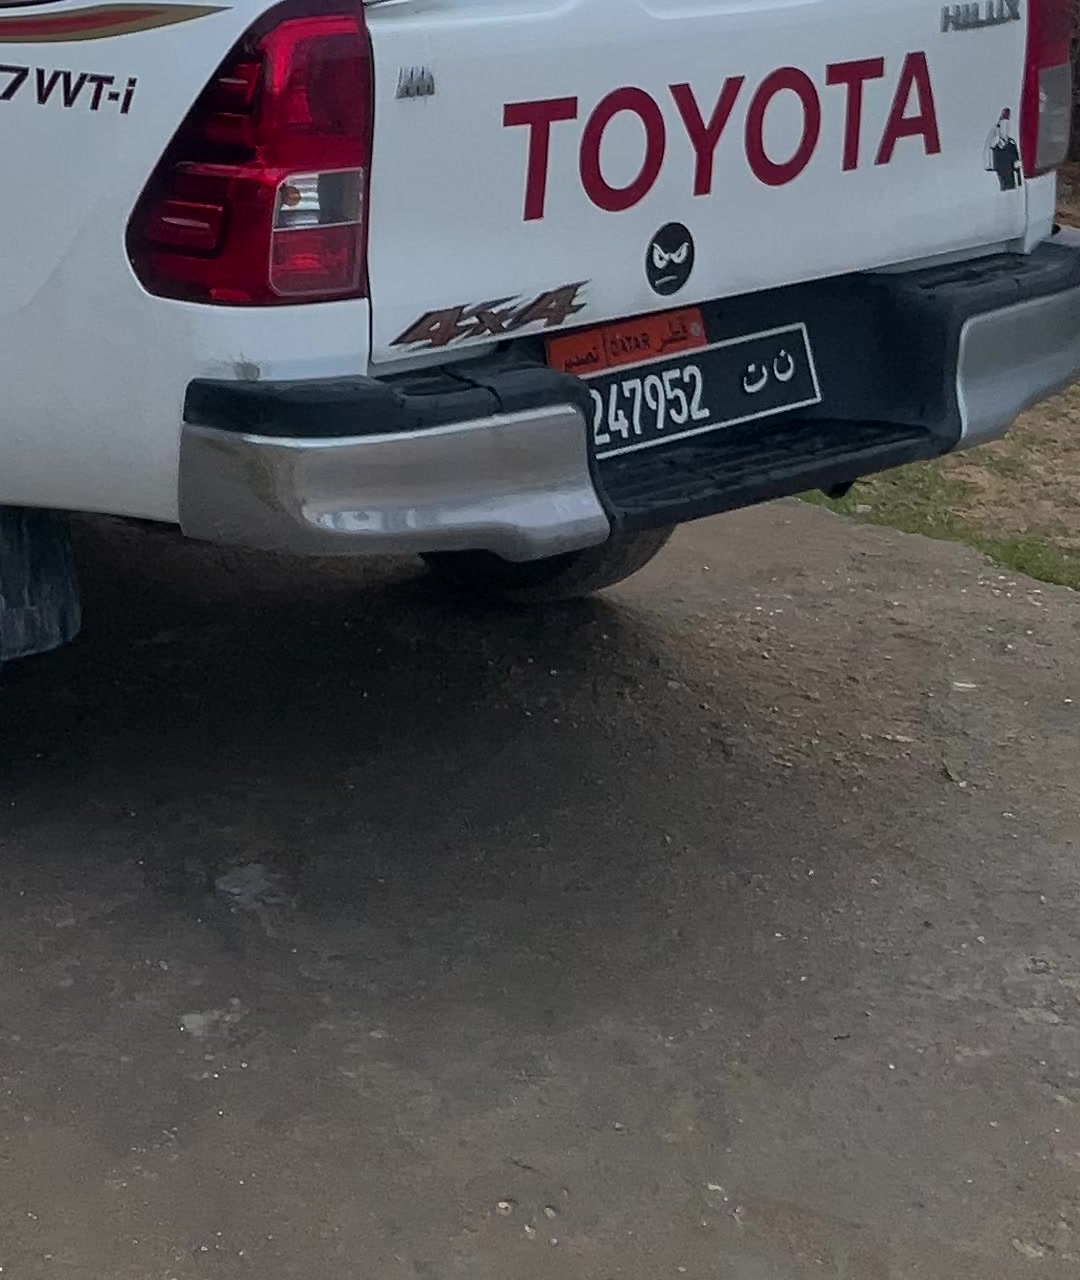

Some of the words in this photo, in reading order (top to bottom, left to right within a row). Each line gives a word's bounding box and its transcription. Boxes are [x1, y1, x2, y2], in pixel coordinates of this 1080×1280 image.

[503, 51, 941, 221] TOYOTA
[609, 333, 650, 357] QATAR
[589, 365, 710, 446] 247952
